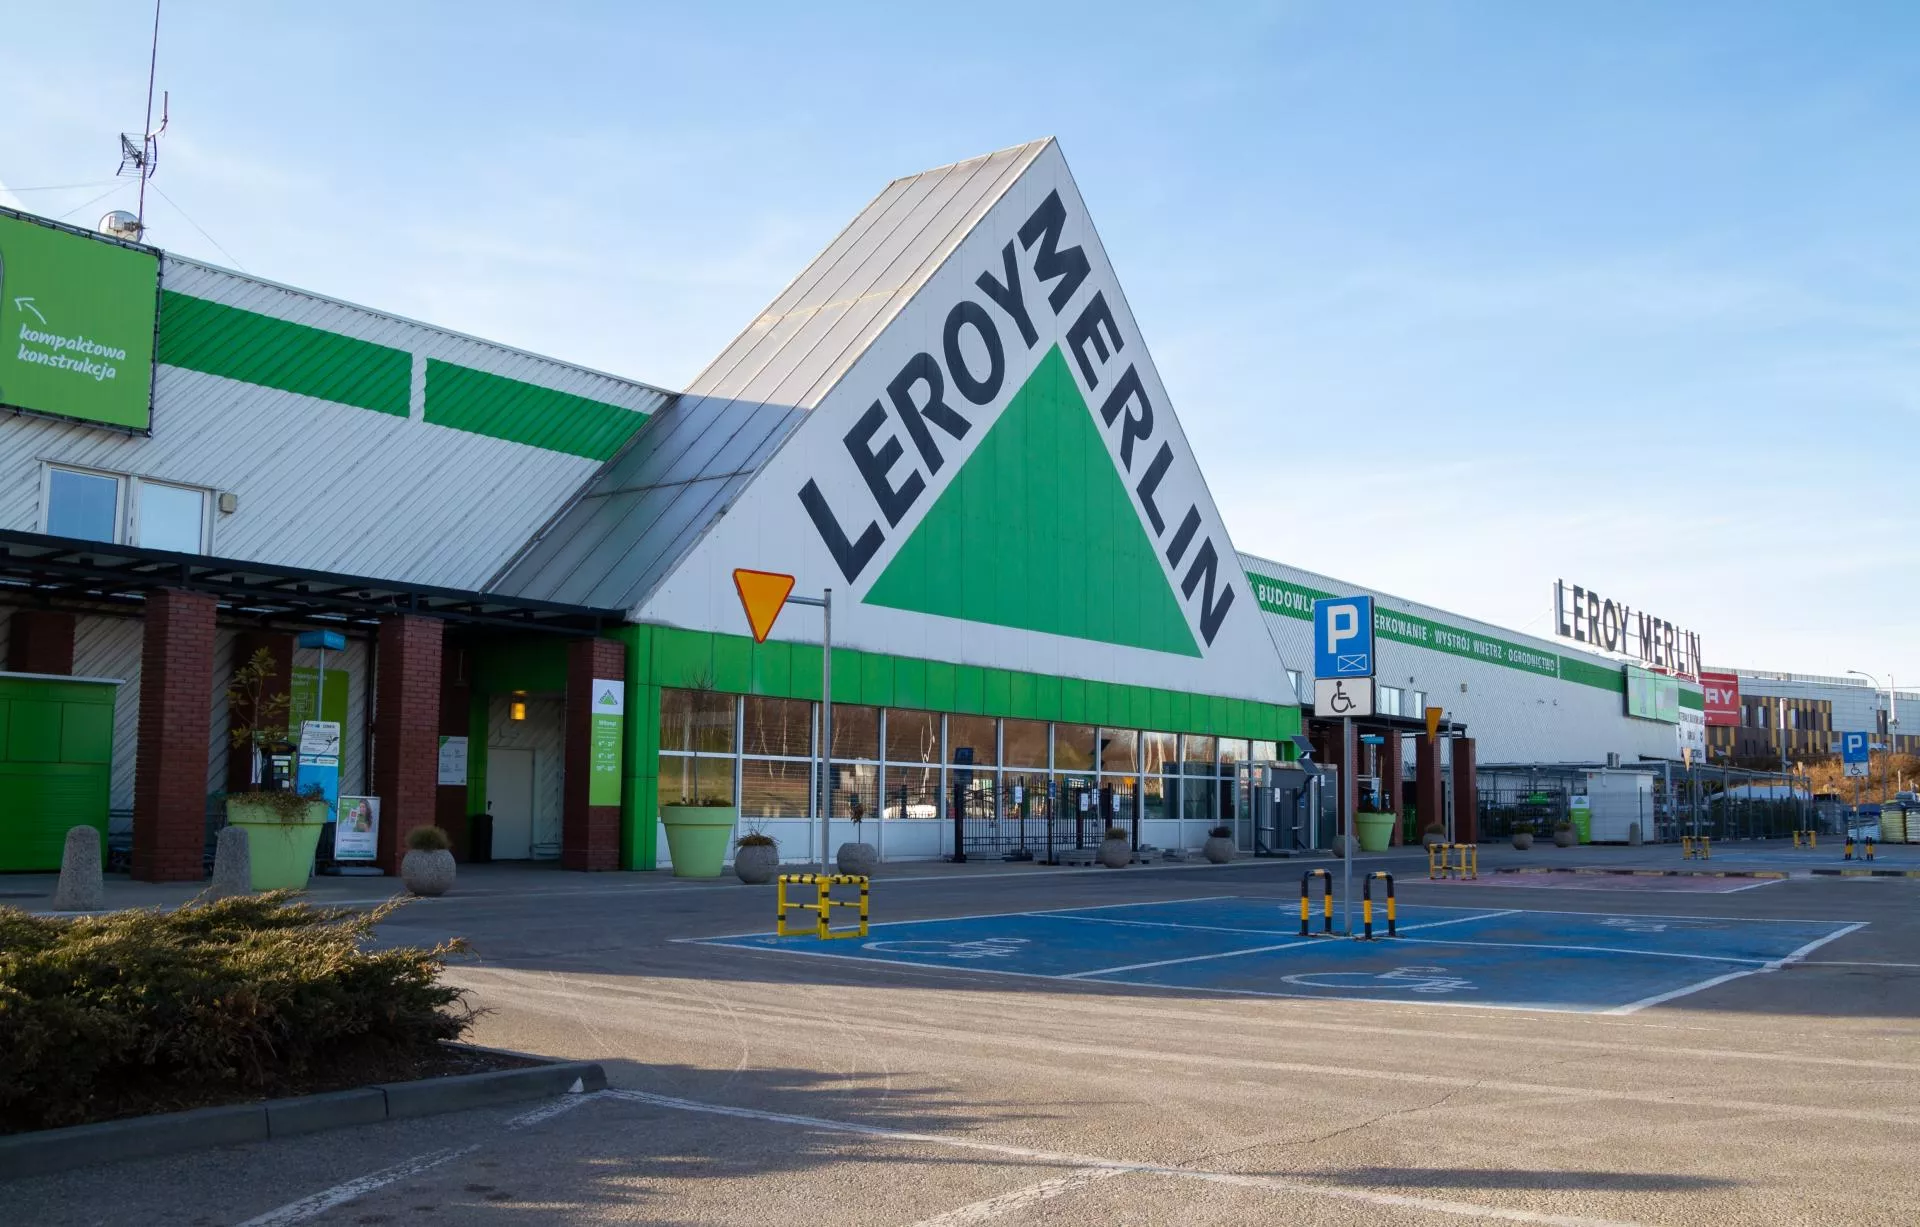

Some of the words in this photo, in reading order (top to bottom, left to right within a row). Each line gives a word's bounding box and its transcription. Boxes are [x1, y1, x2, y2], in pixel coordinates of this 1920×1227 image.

[18, 343, 117, 381] konstrukcja
[19, 323, 126, 360] kompaktowa
[798, 239, 1039, 586] LEROY
[1017, 188, 1235, 648] MERLIN
[1258, 584, 1315, 612] BUDOWLA
[1374, 614, 1427, 641] ERKOWANIE
[1434, 629, 1470, 651] WYSTRÓJ
[1327, 604, 1358, 654] P
[1556, 578, 1629, 654] LEROY
[1638, 610, 1701, 680] MERLIN
[1705, 688, 1733, 705] RY
[1848, 735, 1862, 753] P
